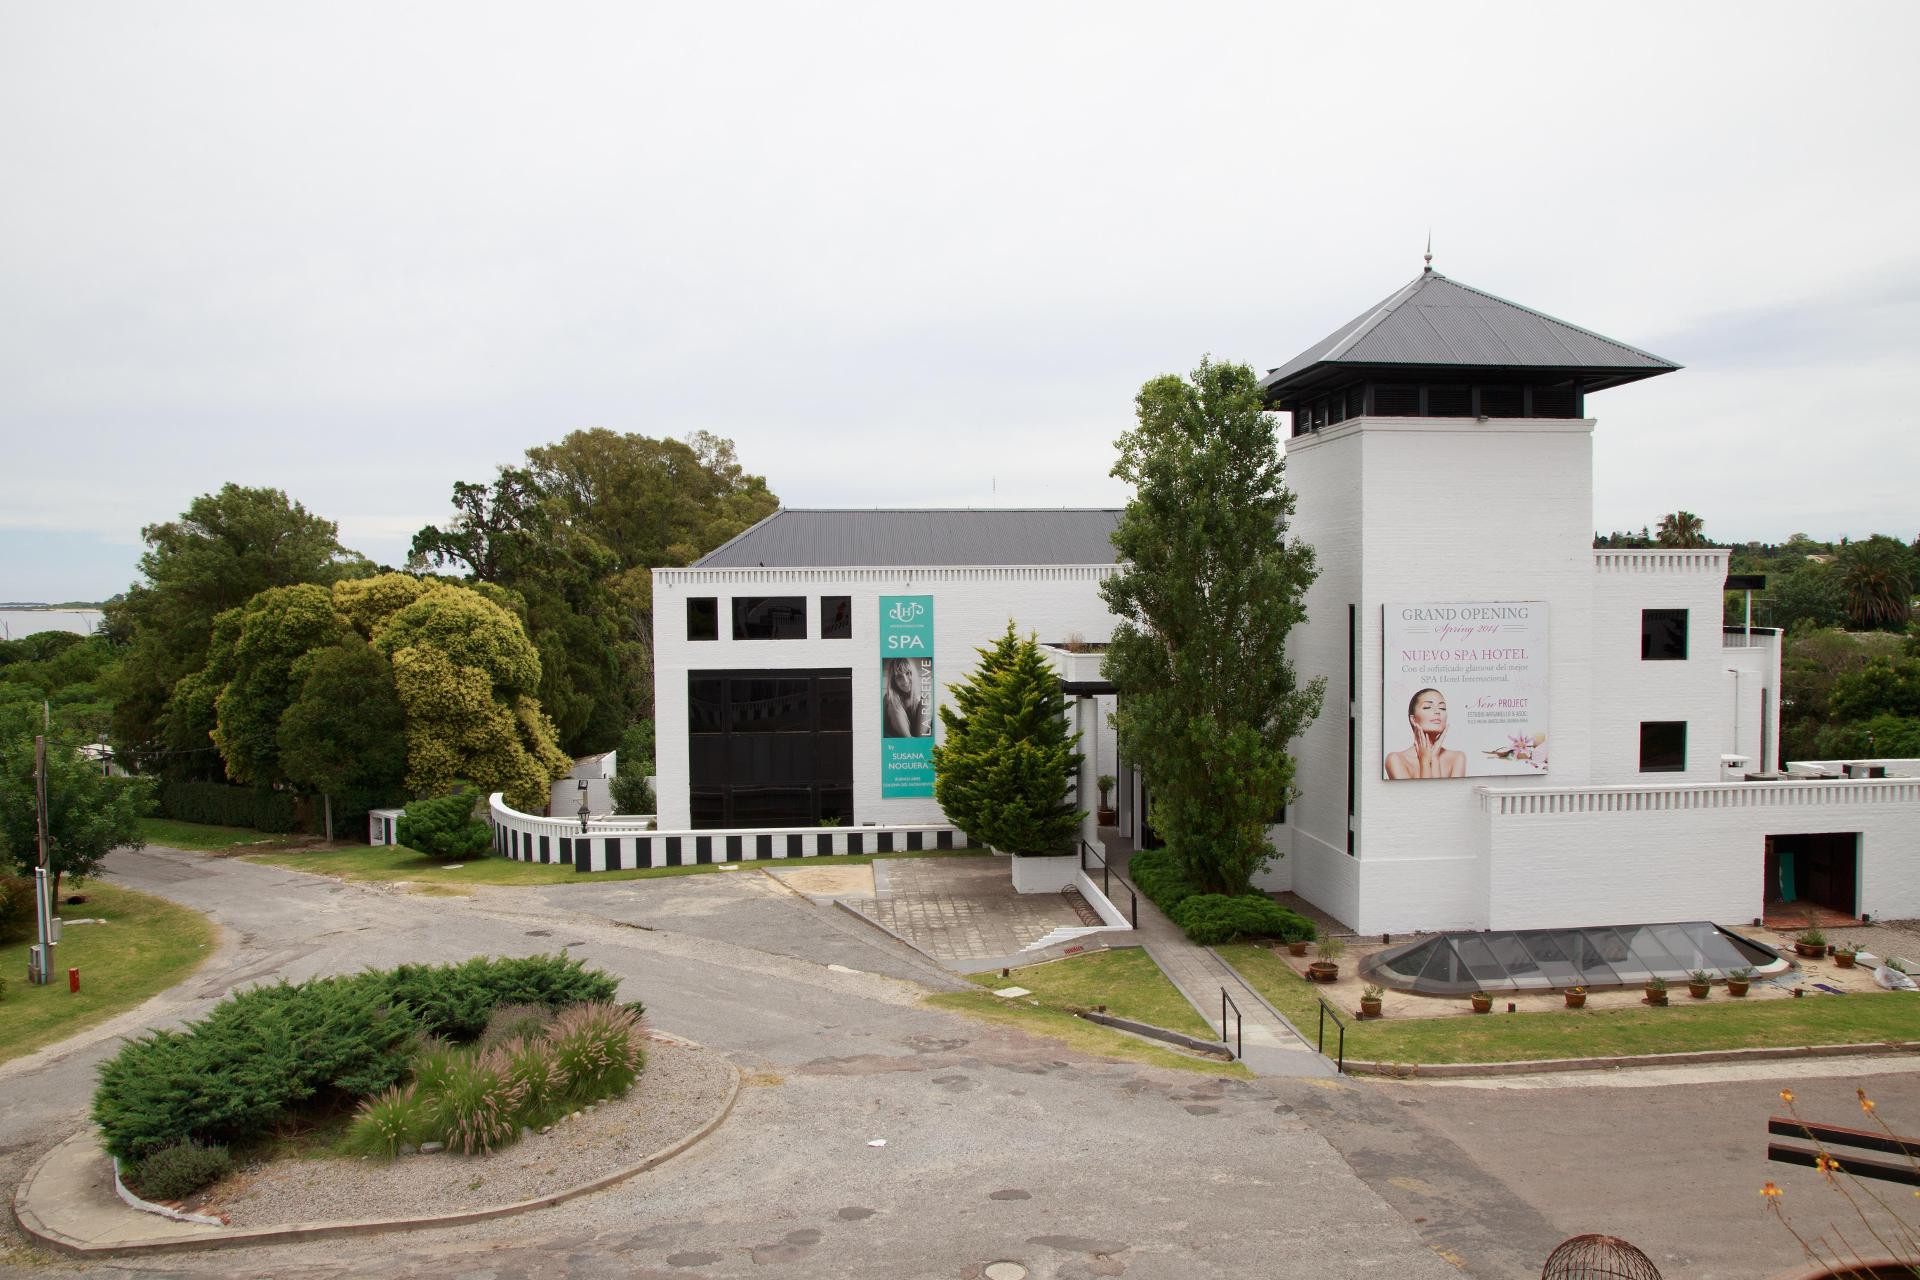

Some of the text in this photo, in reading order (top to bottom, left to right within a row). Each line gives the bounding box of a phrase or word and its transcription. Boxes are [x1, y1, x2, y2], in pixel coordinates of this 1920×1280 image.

[1402, 607, 1528, 621] GRAND OPENING
[1434, 622, 1474, 641] Spring
[888, 635, 925, 649] SPA
[1402, 648, 1528, 661] NUEVO SPA HOTEL
[1401, 664, 1417, 673] Con
[1419, 664, 1426, 673] el
[1496, 663, 1507, 671] del
[1509, 663, 1528, 672] mejor
[1421, 675, 1437, 683] SPA
[921, 659, 931, 735] LA RESERVE
[1498, 698, 1528, 708] PROJECT
[892, 753, 925, 761] SUSANA
[888, 762, 929, 770] NOGUERA
